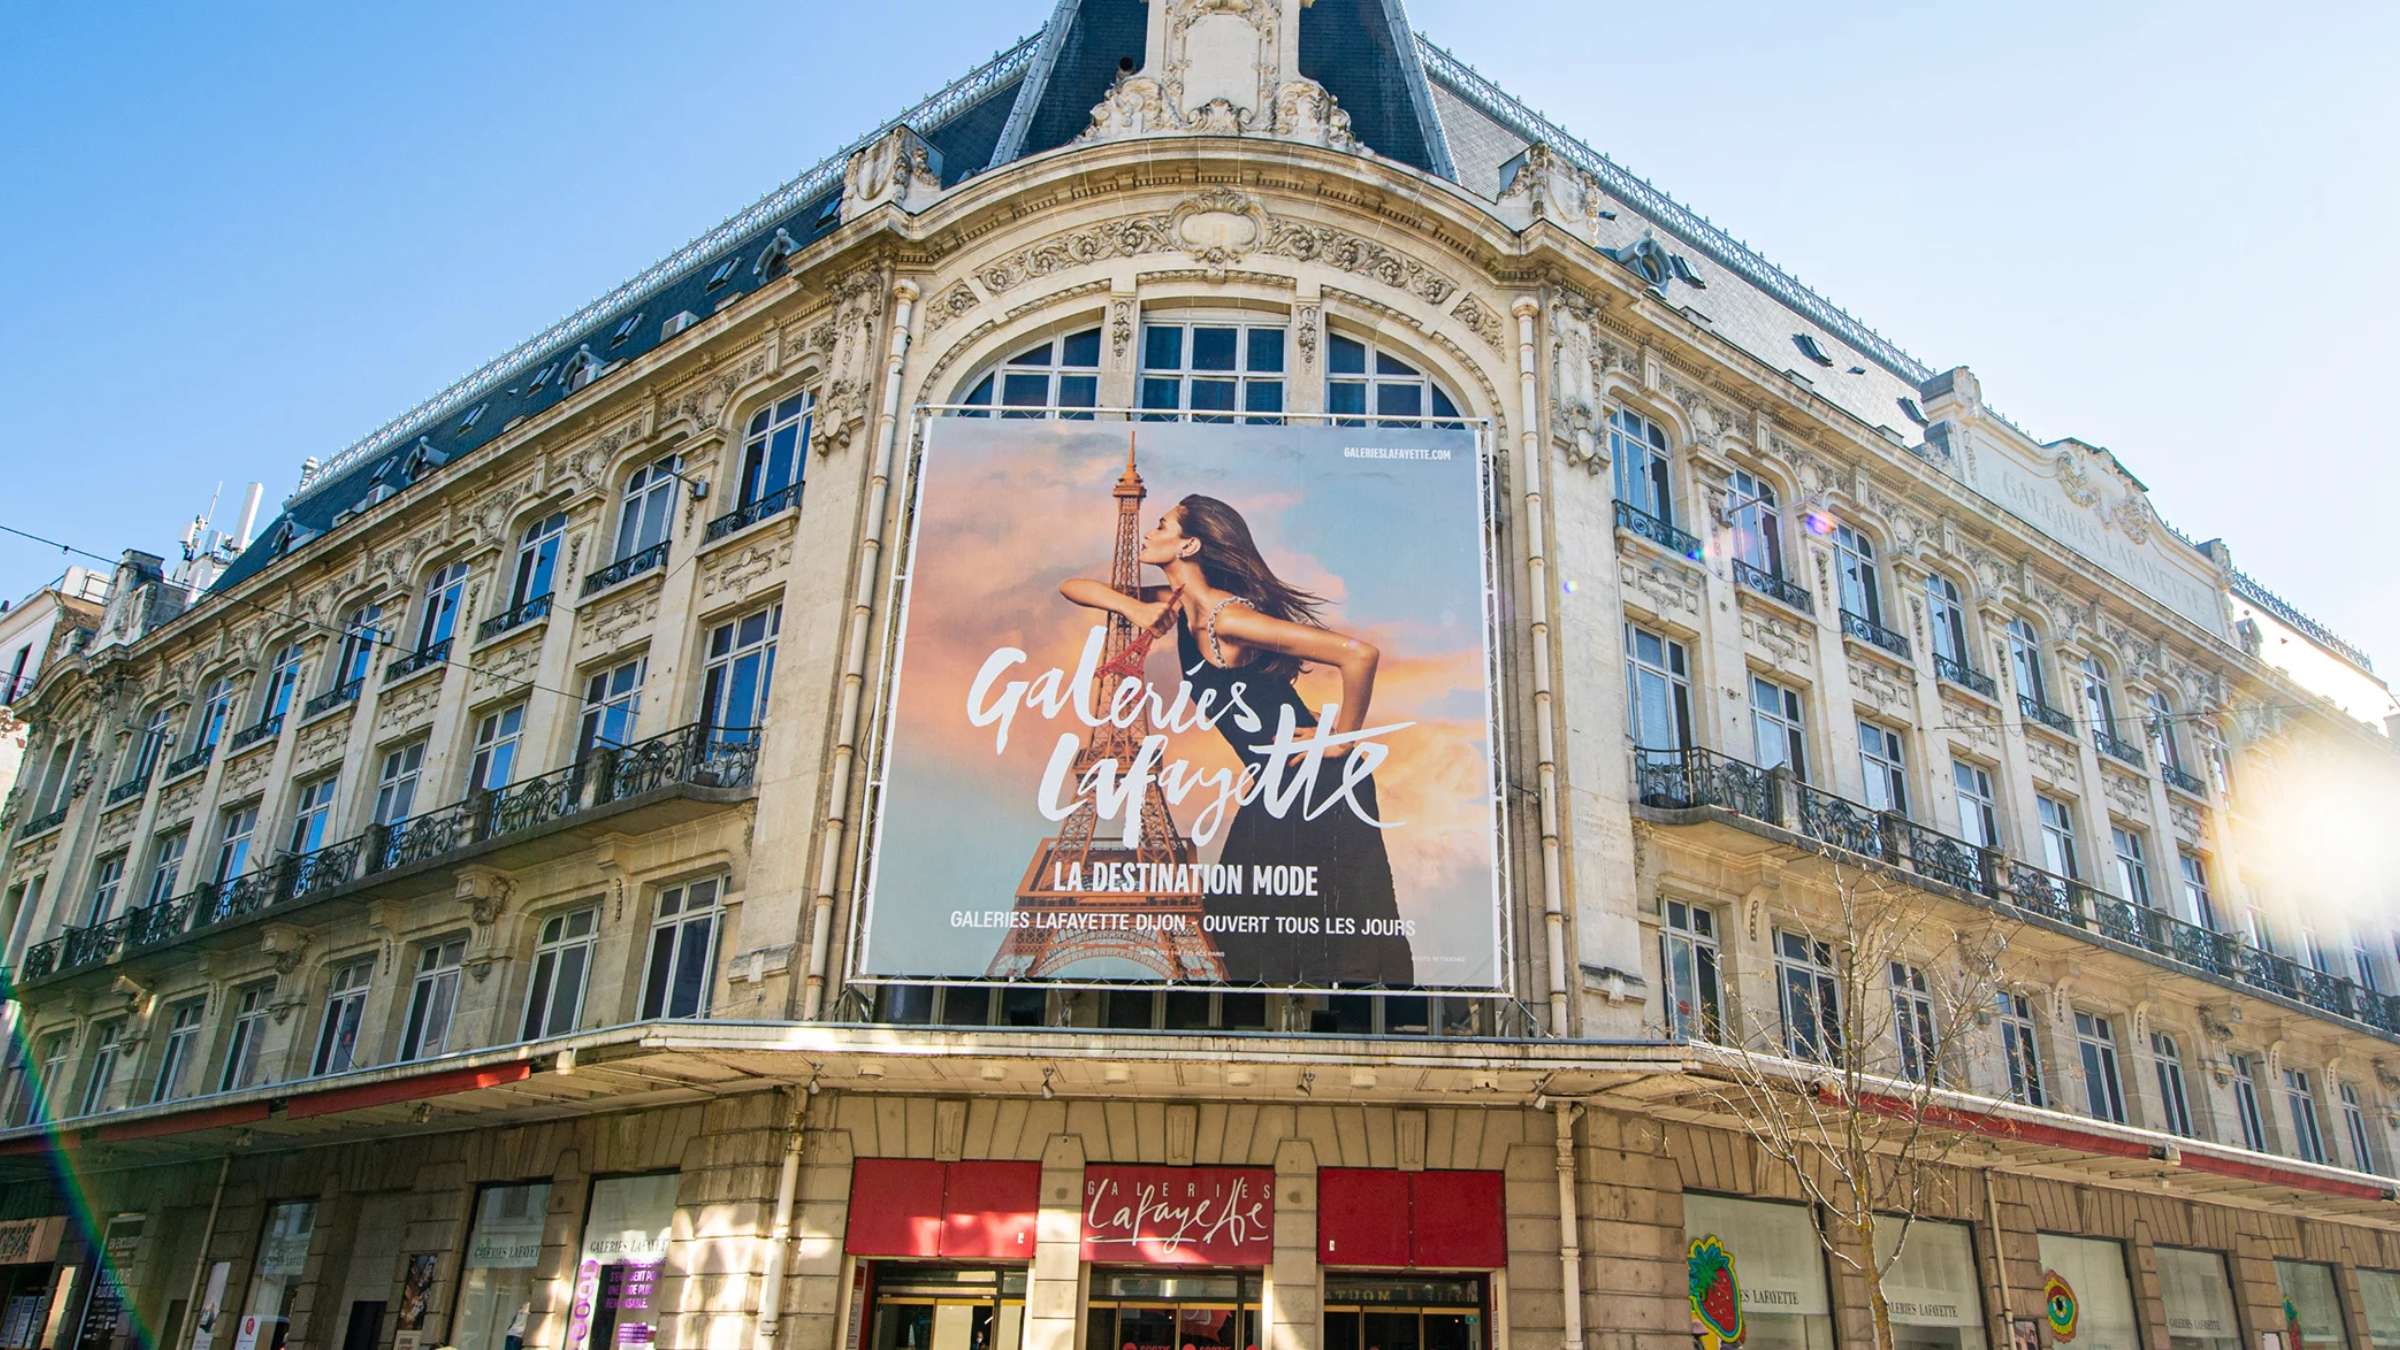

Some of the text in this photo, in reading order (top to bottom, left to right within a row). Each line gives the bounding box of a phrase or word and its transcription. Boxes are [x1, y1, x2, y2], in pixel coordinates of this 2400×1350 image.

[1344, 446, 1451, 460] GALERIESLAFAYETTE.COM
[2003, 470, 2100, 547] GALERIES
[966, 625, 1262, 754] Galeries
[1038, 703, 1416, 848] Lafayette
[1053, 861, 1318, 896] LA DESTINATION MODE
[950, 910, 1030, 928] GALERIES
[1036, 912, 1130, 930] LAFAYETTE
[1136, 913, 1187, 932] DIJON
[1203, 915, 1270, 933] OUVERT
[1275, 916, 1320, 934] TOUS
[1325, 917, 1356, 935] LES
[1361, 918, 1416, 936] JOURS
[1088, 1180, 1271, 1199] GALERIES
[1085, 1177, 1268, 1254] Lafayette
[590, 1240, 628, 1254] GALERIES
[1752, 1289, 1799, 1305] LAFAYETTE
[1919, 1303, 1958, 1318] LAFAYETTE
